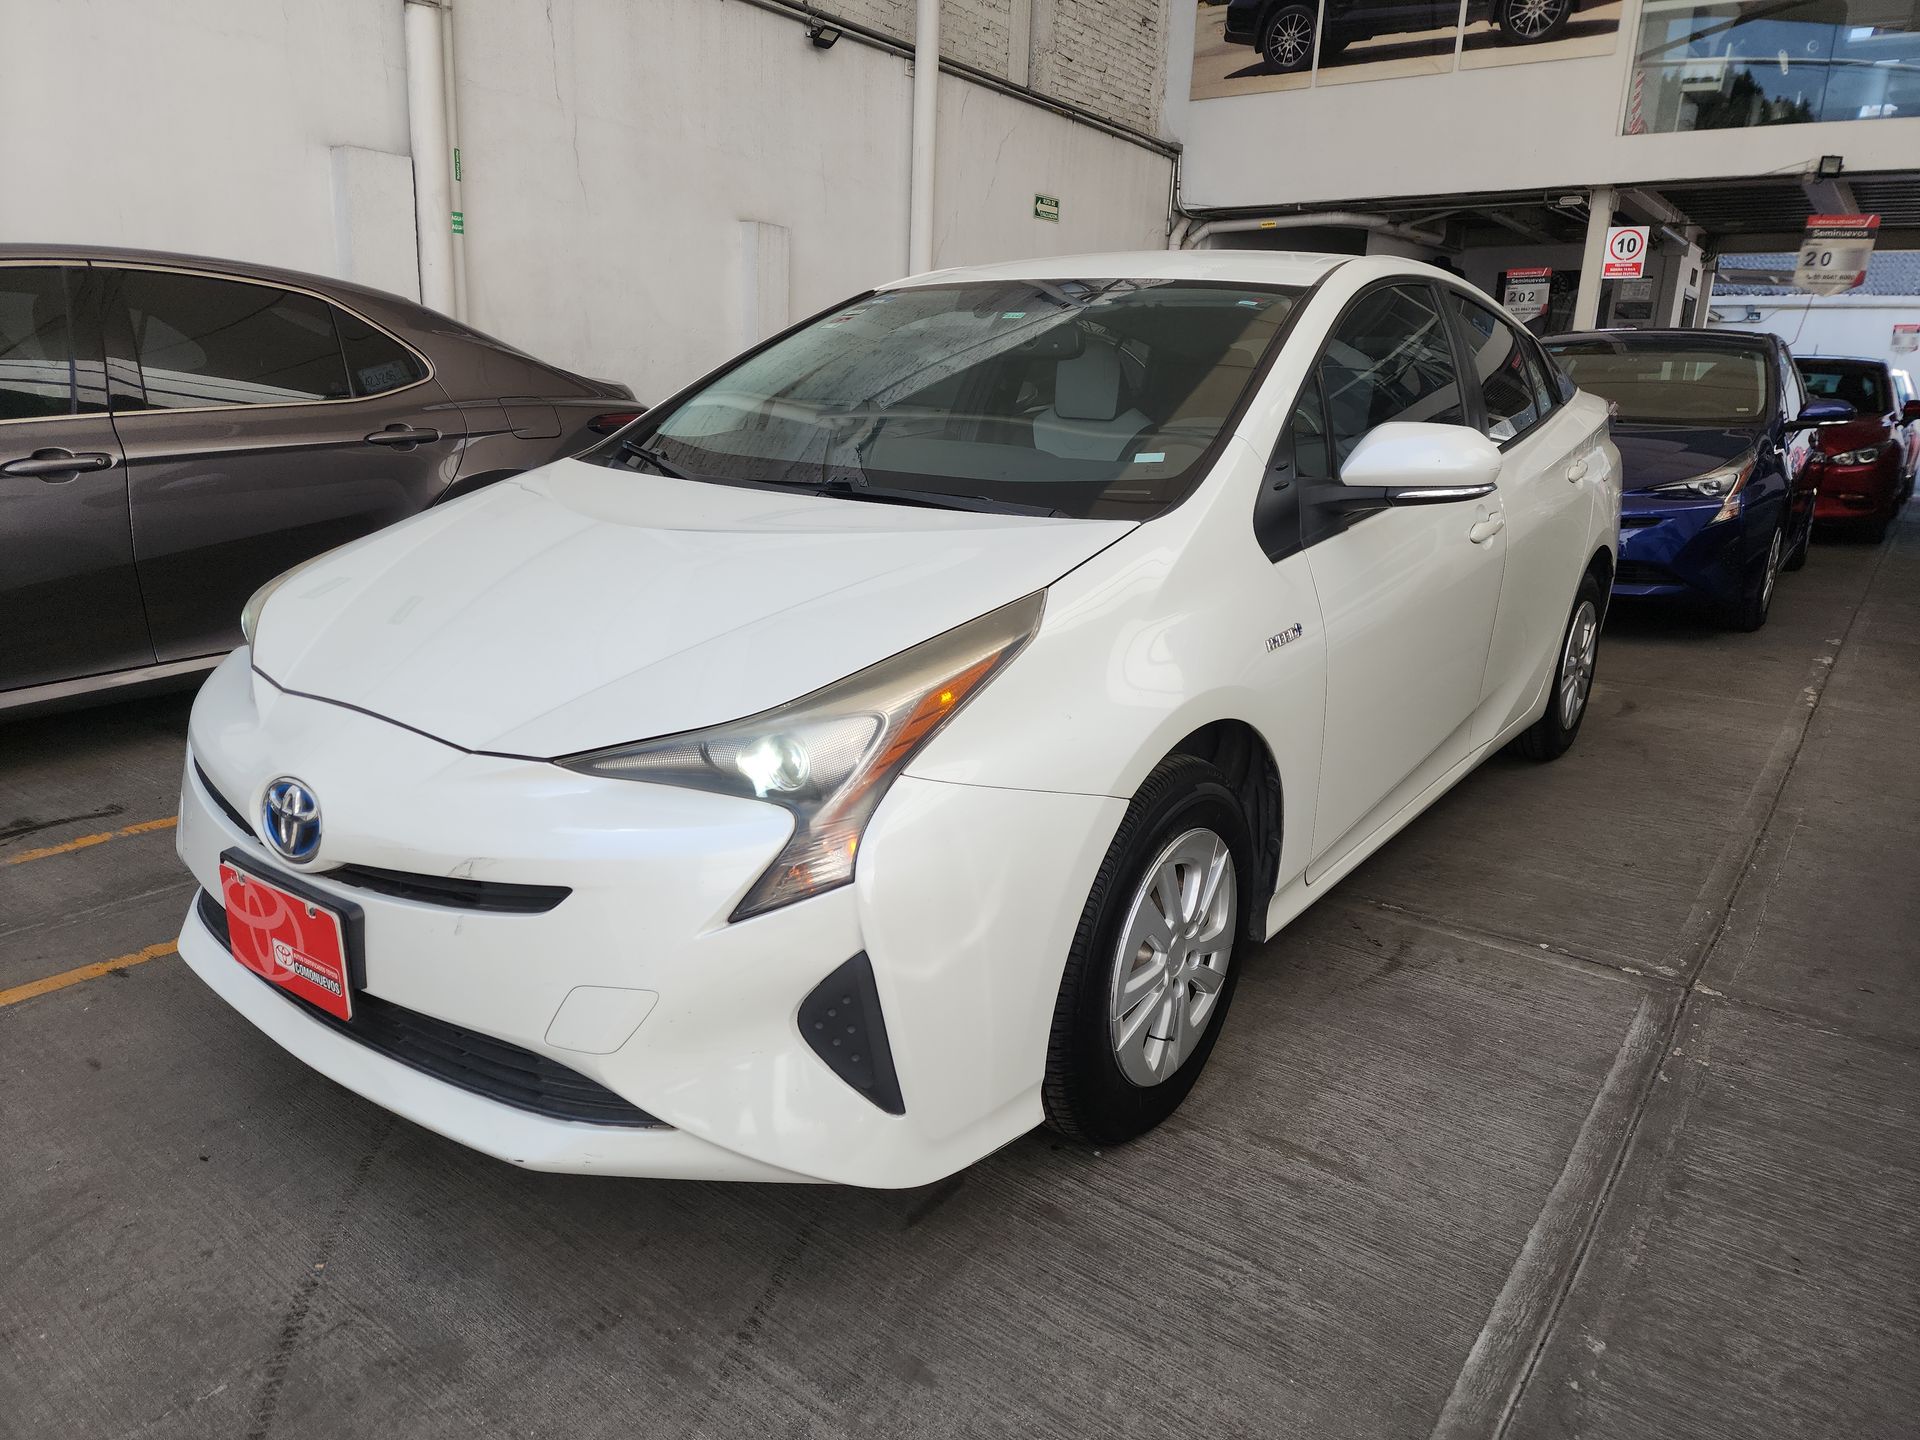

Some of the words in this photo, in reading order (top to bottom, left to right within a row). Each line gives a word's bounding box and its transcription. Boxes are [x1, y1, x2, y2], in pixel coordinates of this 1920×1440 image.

[1812, 229, 1868, 237] Seminuevos
[1618, 238, 1637, 253] 10
[295, 962, 340, 994] COMONUEVOS
